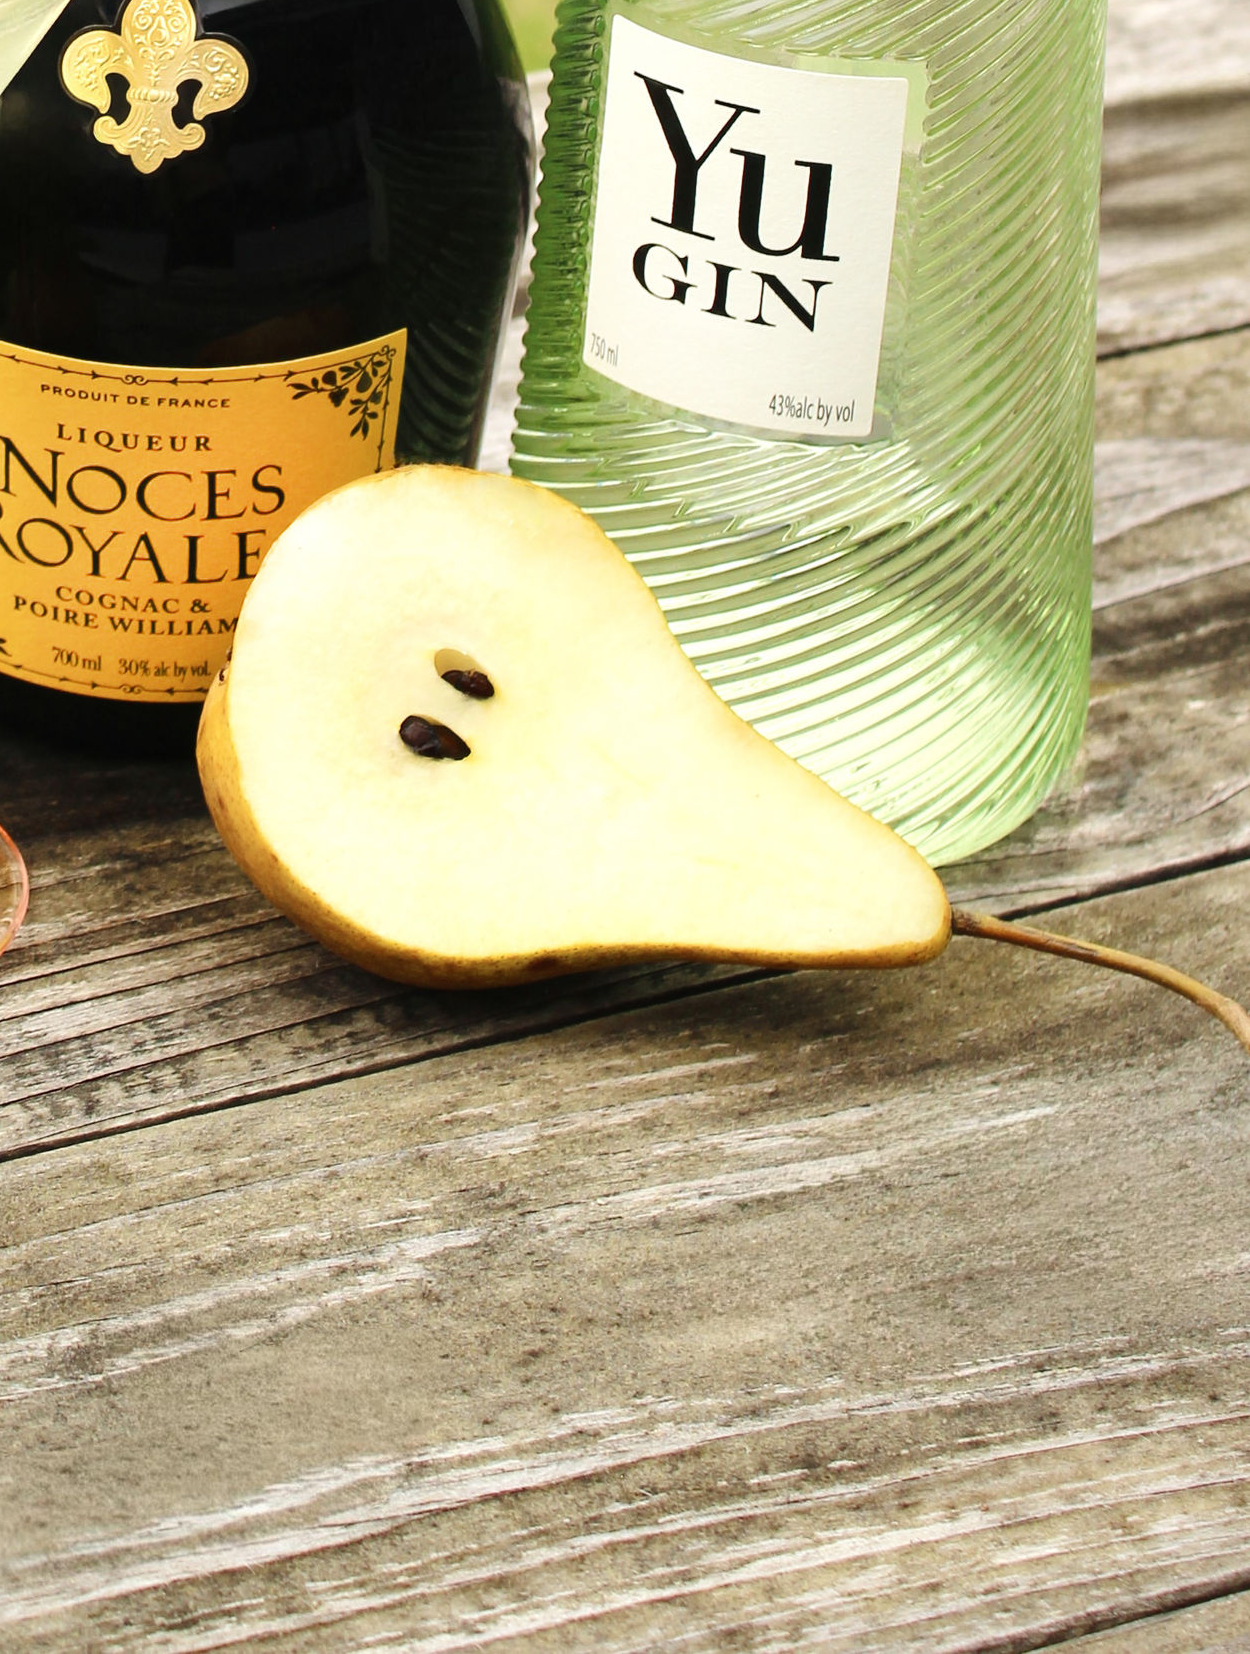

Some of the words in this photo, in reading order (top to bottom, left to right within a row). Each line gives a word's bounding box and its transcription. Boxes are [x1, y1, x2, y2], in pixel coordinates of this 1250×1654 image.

[633, 70, 840, 262] Yu
[632, 243, 833, 333] GIN
[591, 333, 605, 359] 750
[607, 344, 619, 367] ml
[40, 384, 120, 403] PRODUIT
[126, 395, 150, 406] DE
[157, 397, 230, 408] FRANCE
[816, 398, 833, 427] by
[836, 400, 855, 422] vol
[57, 423, 212, 453] LIQUEUR
[14, 595, 99, 629] POIRE
[55, 586, 179, 614] COGNAC
[189, 598, 212, 614] &
[52, 646, 79, 667] 700
[82, 655, 101, 671] ml
[119, 658, 149, 676] 30%
[154, 661, 170, 677] alc
[174, 662, 188, 682] by
[190, 660, 212, 677] vol.
